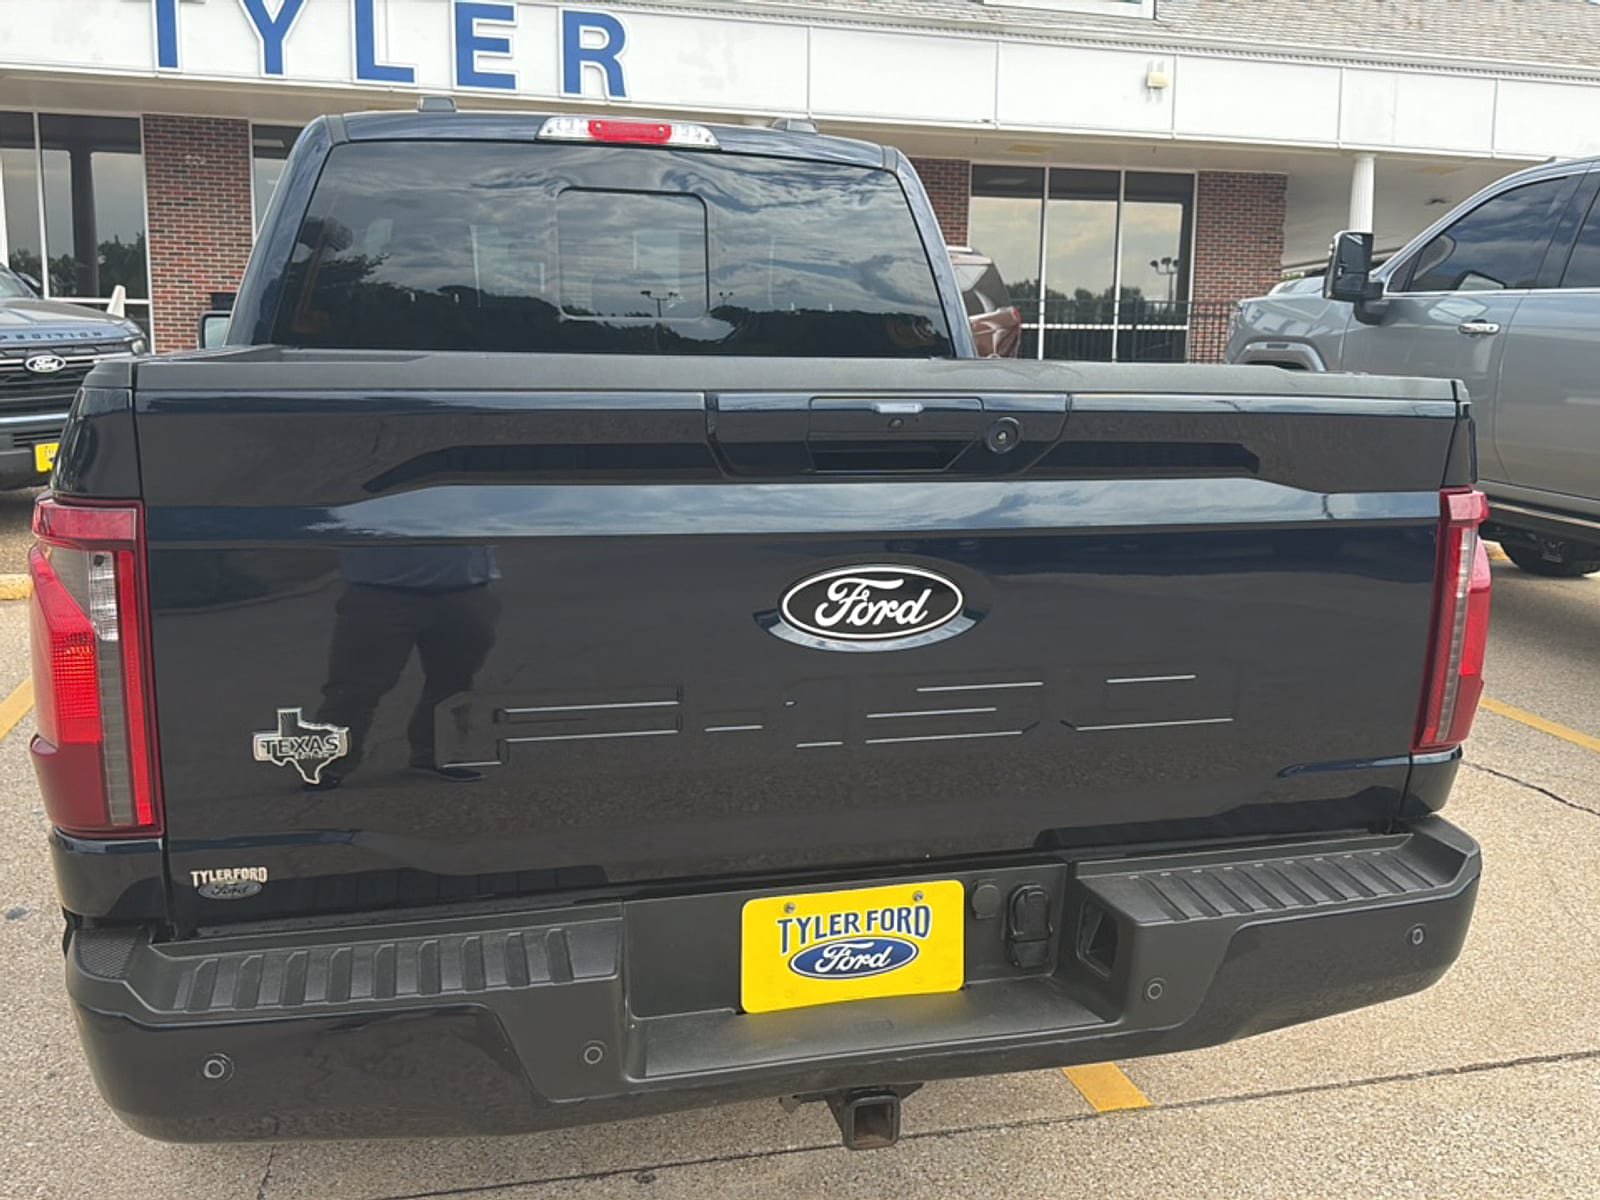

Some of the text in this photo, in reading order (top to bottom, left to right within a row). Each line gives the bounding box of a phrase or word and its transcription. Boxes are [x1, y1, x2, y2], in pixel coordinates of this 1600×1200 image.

[815, 577, 932, 626] Ford
[259, 734, 340, 755] TEXAS
[777, 905, 931, 954] TYLER FORD
[814, 941, 893, 972] Ford
